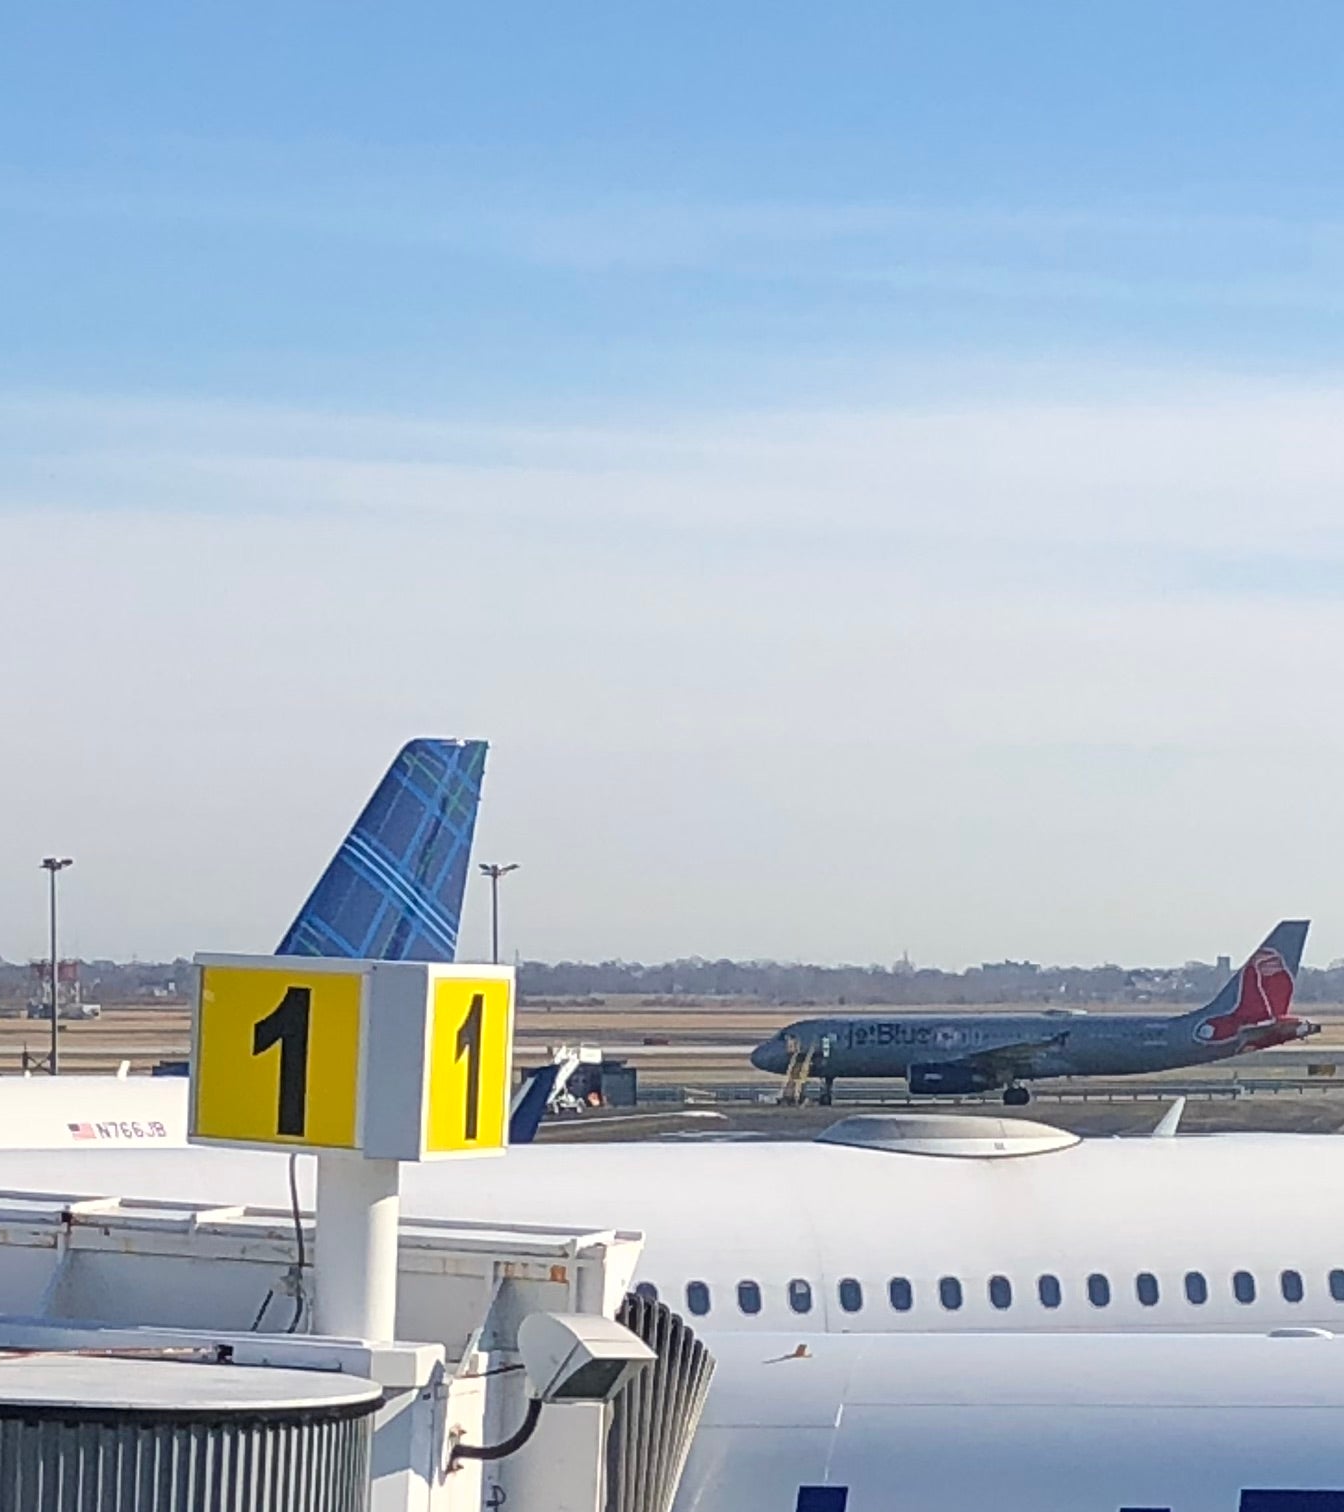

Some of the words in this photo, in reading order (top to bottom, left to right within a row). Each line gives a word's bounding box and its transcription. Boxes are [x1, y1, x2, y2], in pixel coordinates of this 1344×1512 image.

[253, 987, 311, 1137] 1
[455, 994, 484, 1141] 1
[847, 1022, 932, 1050] jetBlue
